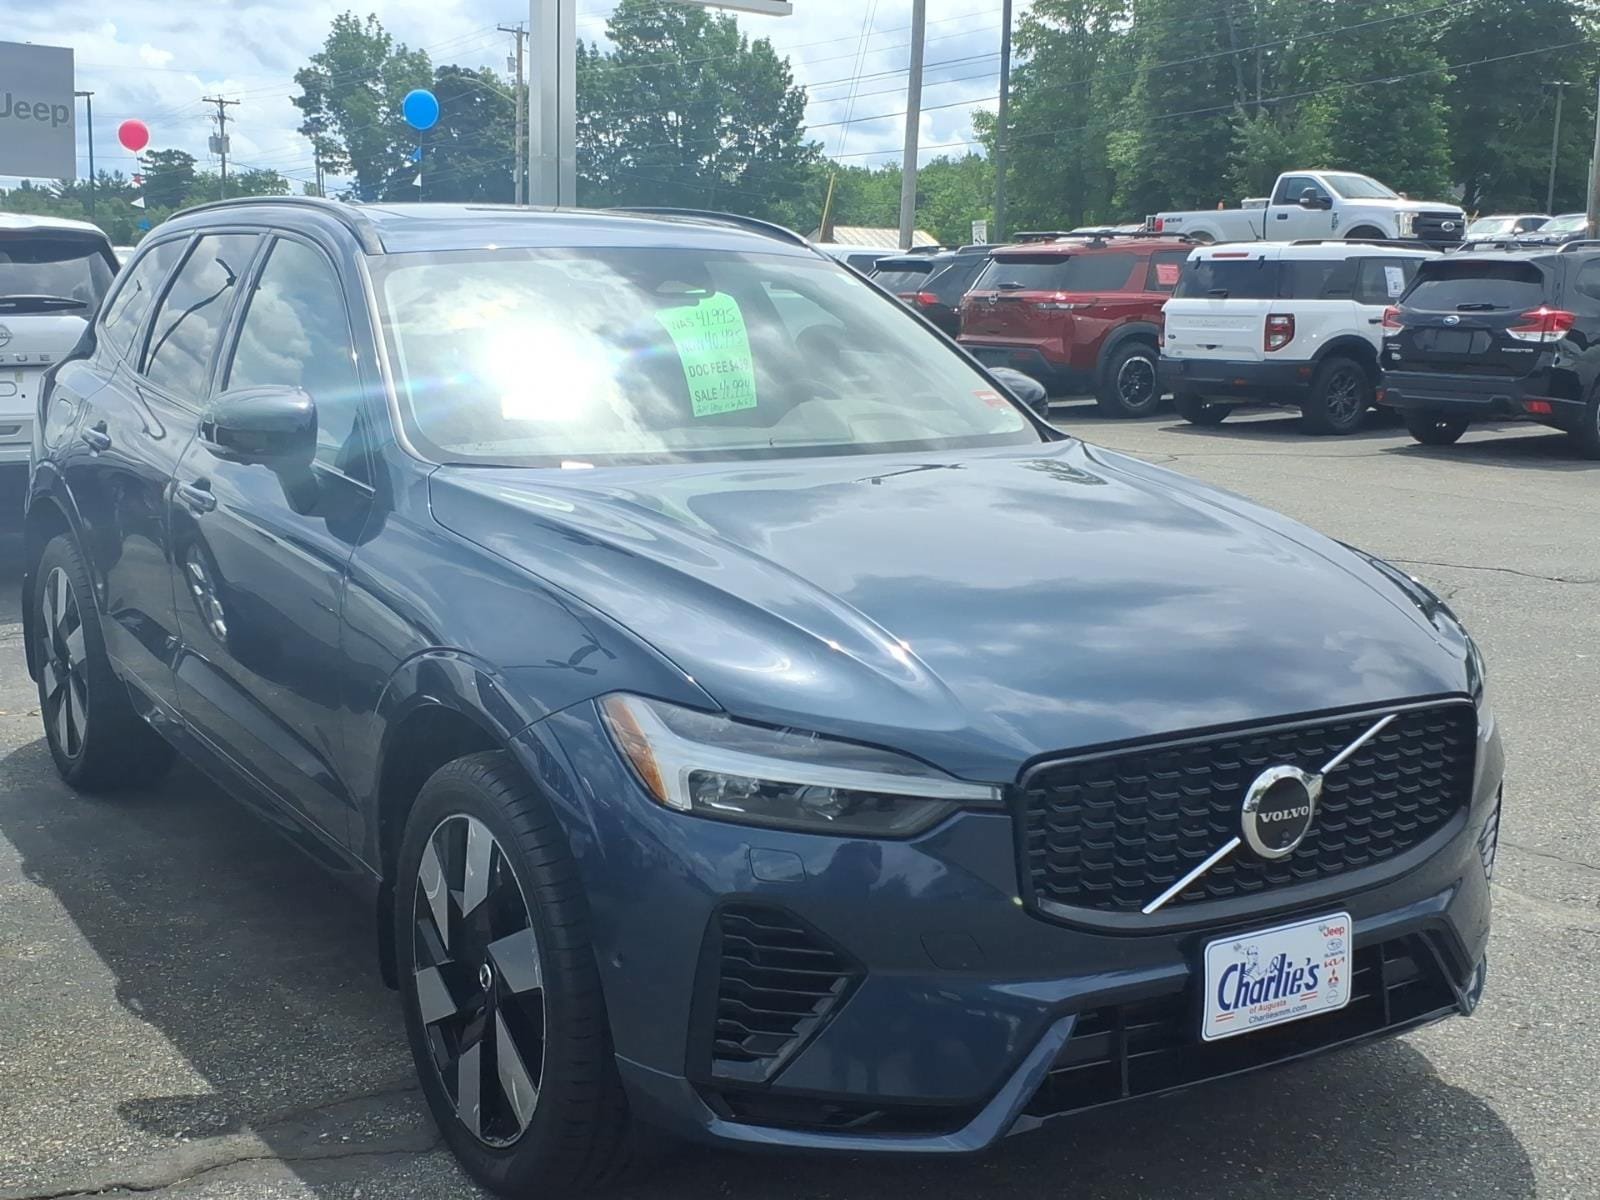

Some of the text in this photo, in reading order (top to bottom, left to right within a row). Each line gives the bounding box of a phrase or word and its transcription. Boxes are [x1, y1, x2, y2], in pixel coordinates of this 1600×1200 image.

[0, 92, 70, 128] Jeep
[687, 363, 709, 378] DOC
[710, 360, 728, 374] FEE
[694, 387, 718, 402] SALE
[1259, 806, 1309, 823] VOLVO
[1323, 926, 1345, 937] Jeep
[1218, 953, 1319, 1011] Charlie's
